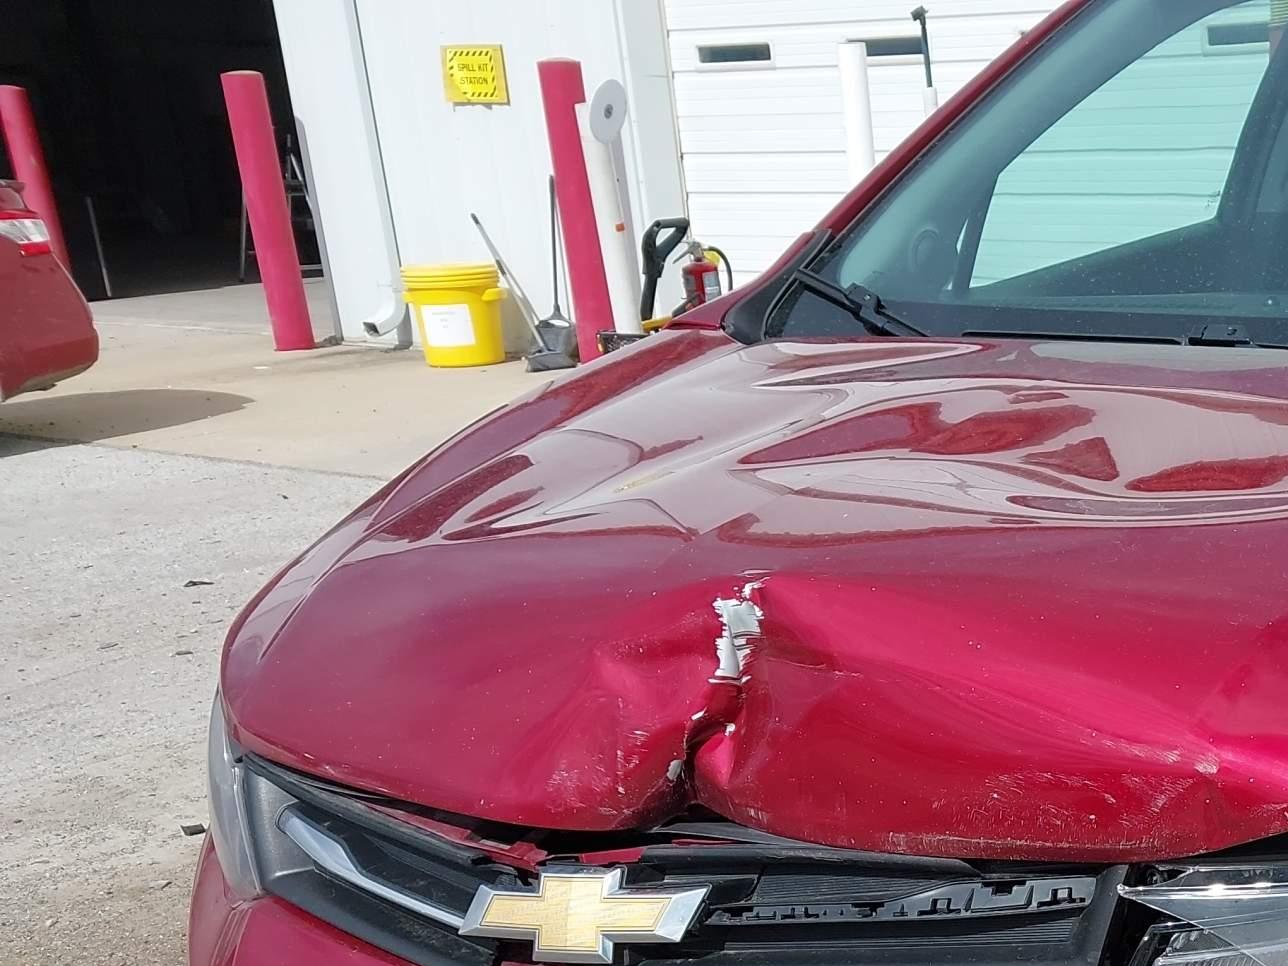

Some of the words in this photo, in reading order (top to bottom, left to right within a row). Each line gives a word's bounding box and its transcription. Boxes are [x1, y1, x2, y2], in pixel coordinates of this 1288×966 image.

[457, 63, 476, 72] SPILL
[478, 63, 488, 72] KIT
[459, 76, 489, 85] STATION
